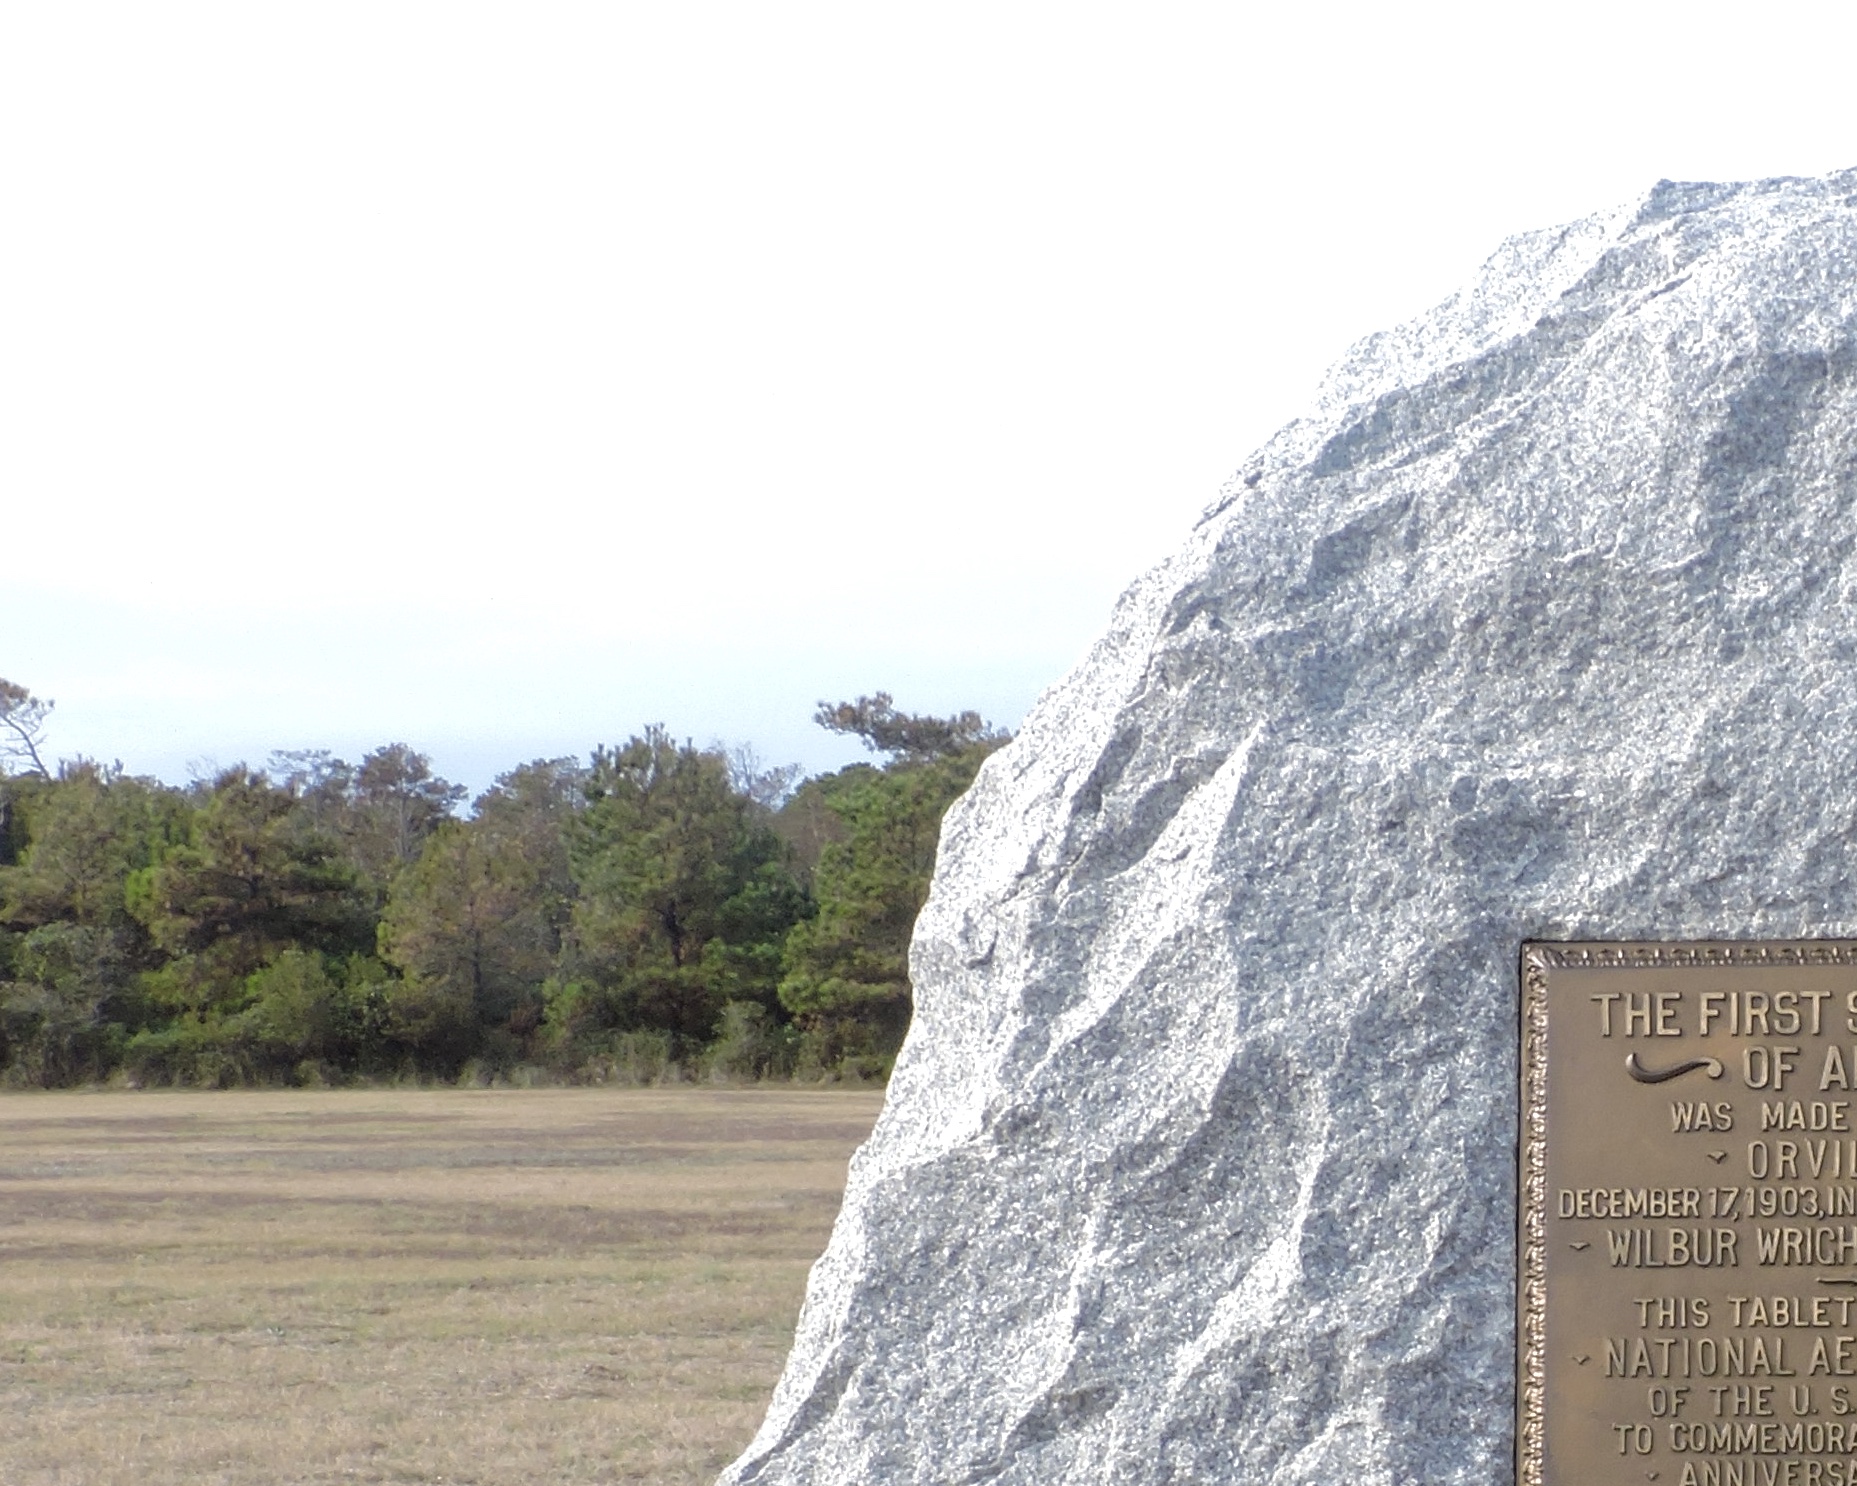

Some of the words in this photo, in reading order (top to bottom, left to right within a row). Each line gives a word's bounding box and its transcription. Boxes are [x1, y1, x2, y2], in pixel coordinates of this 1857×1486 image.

[1591, 991, 1682, 1036] THE
[1700, 990, 1832, 1036] FIRST
[1743, 1046, 1799, 1091] OF
[1670, 1101, 1733, 1132] WAS
[1761, 1101, 1849, 1132] MADE
[1557, 1187, 1701, 1219] DECEMBER
[1709, 1186, 1741, 1221] 17,
[1606, 1227, 1738, 1268] WILBUR
[1634, 1298, 1710, 1328] THIS
[1727, 1296, 1855, 1328] TABLET
[1604, 1336, 1796, 1377] NATIONAL
[1648, 1385, 1691, 1417] OF
[1708, 1385, 1774, 1416] THE
[1612, 1422, 1653, 1455] TO
